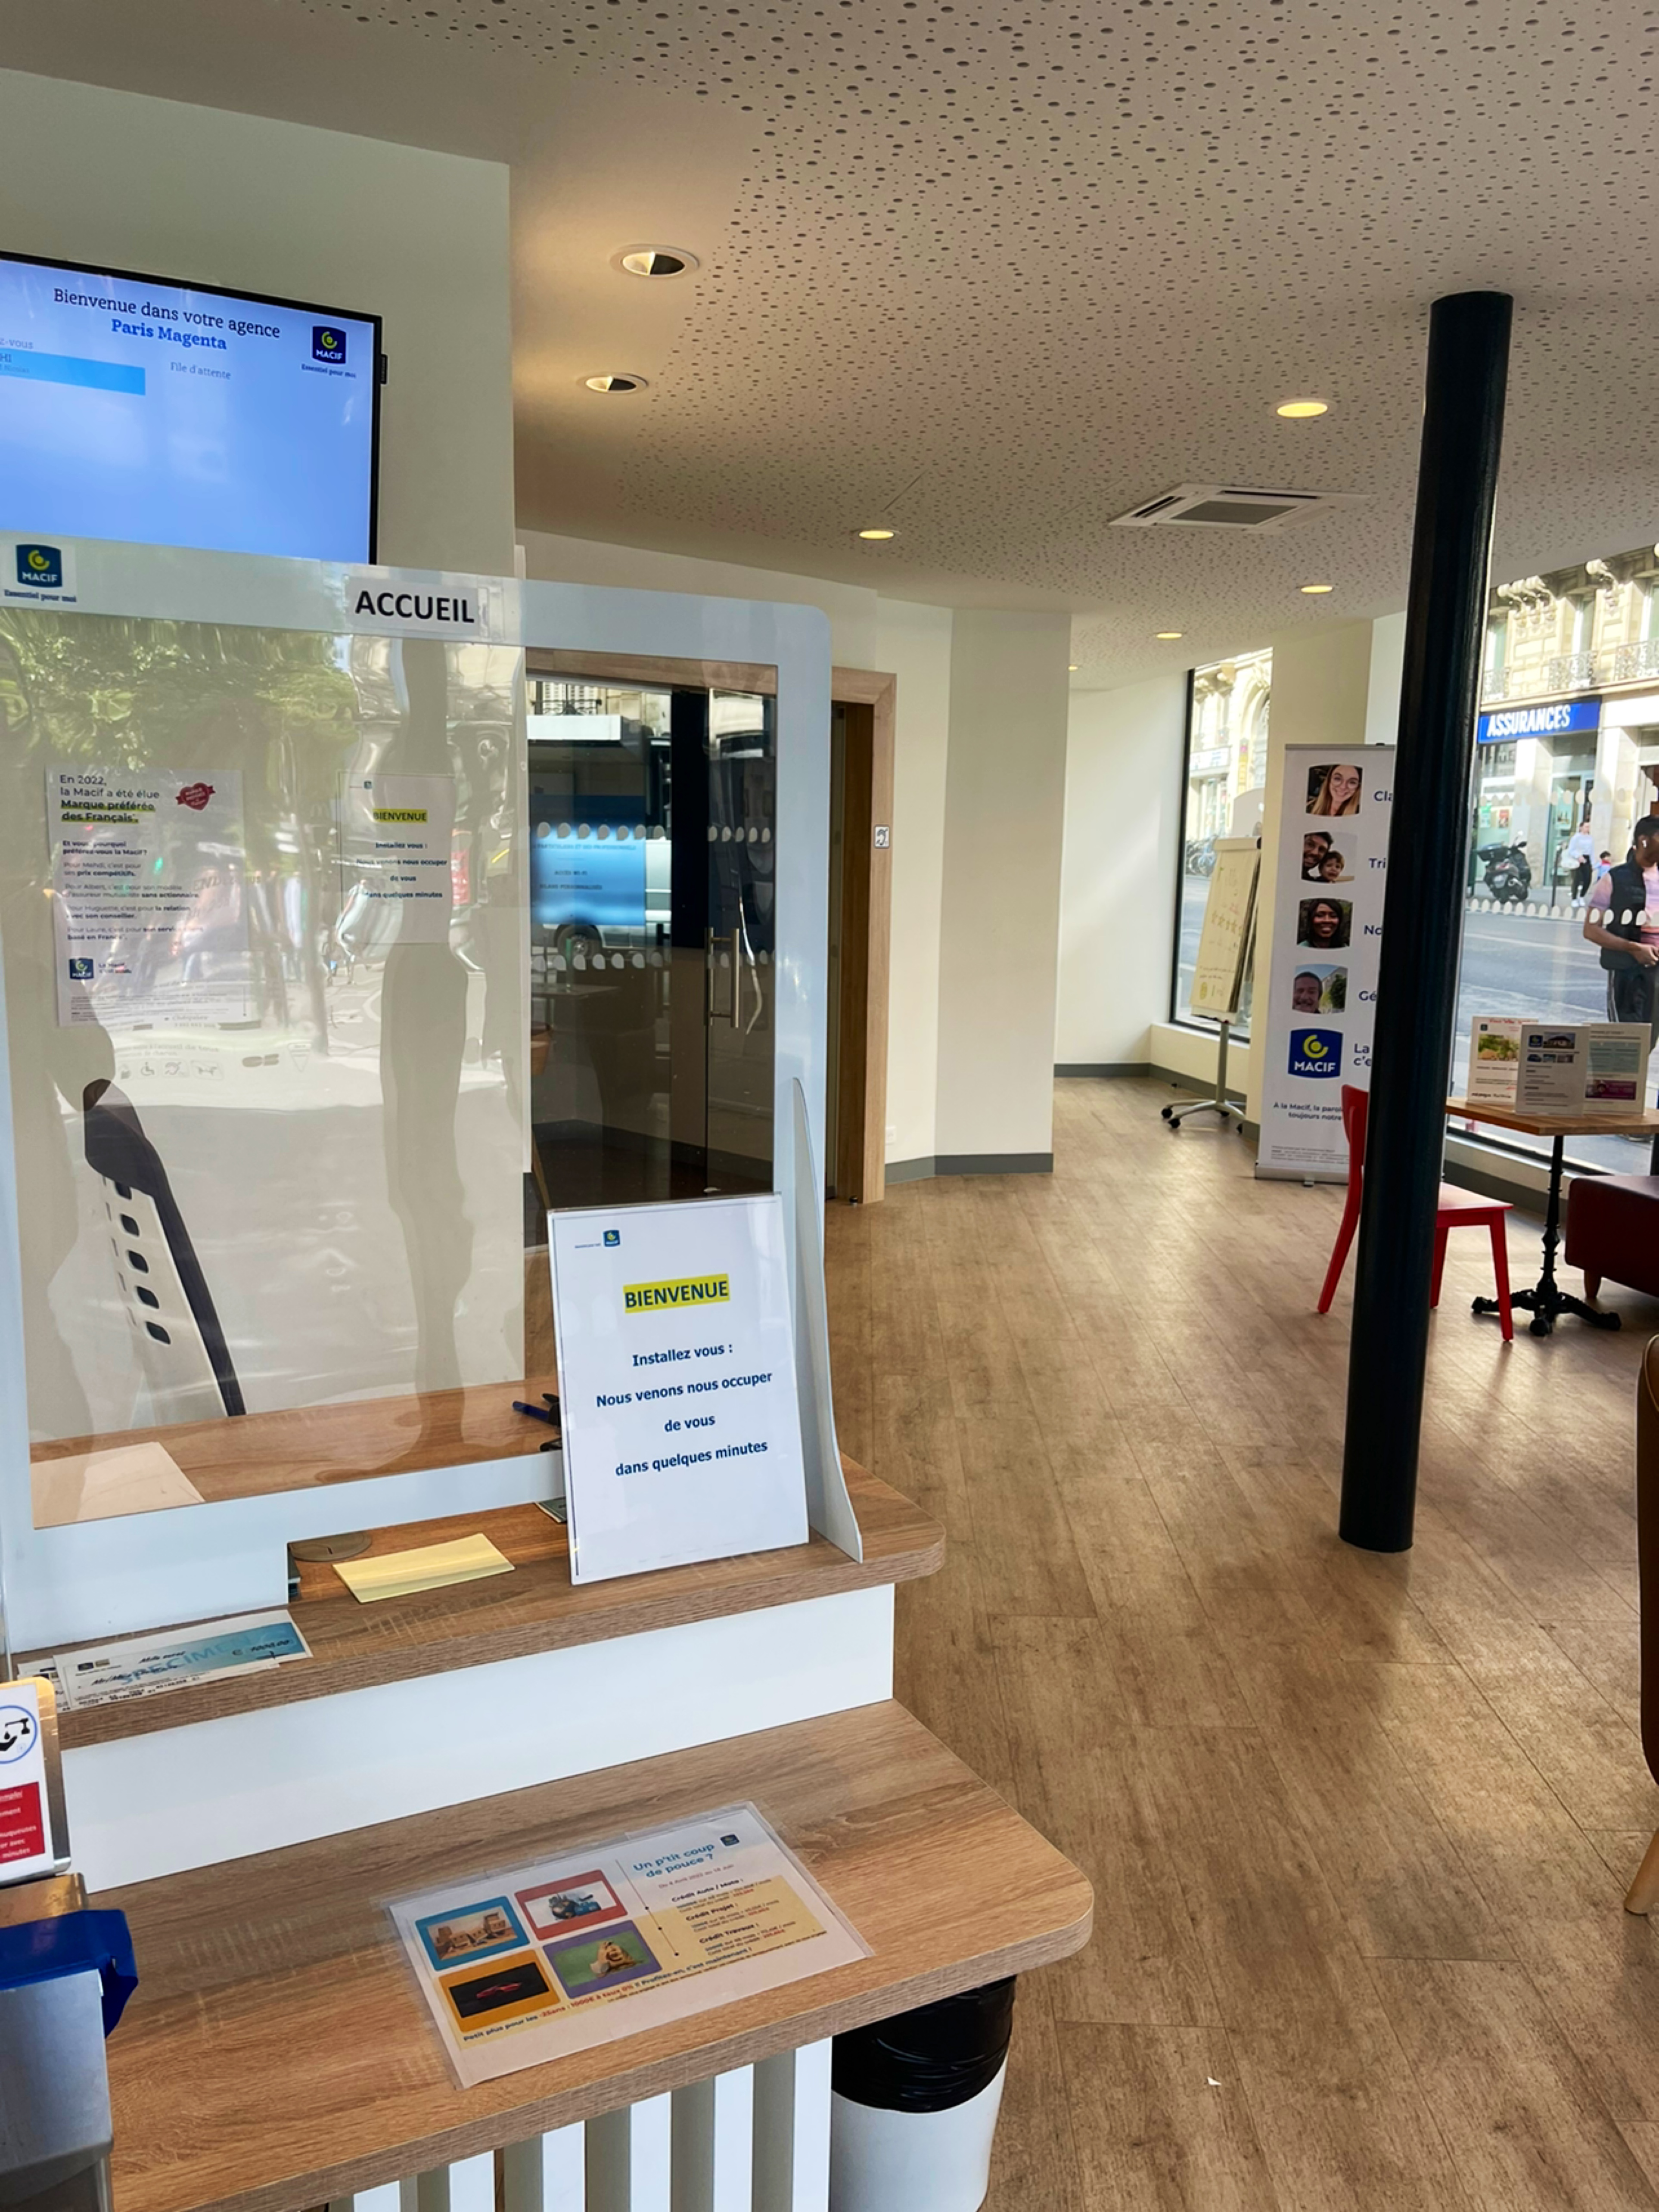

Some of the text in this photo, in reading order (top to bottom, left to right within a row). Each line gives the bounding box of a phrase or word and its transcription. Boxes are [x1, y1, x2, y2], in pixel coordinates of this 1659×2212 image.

[54, 288, 280, 338] Bienvenue dans votre agence
[112, 319, 227, 350] Paris Magenta
[316, 350, 343, 360] MACIF
[171, 361, 231, 379] File d'attente
[22, 572, 58, 583] MACIF
[355, 590, 474, 623] ACCUEIL
[1487, 704, 1571, 737] ASSURANCES
[60, 775, 107, 786] En 2022,
[60, 787, 70, 796] la
[74, 788, 103, 797] Macif
[116, 789, 134, 798] été
[137, 789, 159, 799] élue
[61, 800, 104, 811] Marque
[62, 812, 83, 822] des
[373, 812, 427, 821] BIENVENUE
[1369, 858, 1386, 869] Tri
[1354, 1044, 1370, 1053] La
[1294, 1061, 1336, 1072] MACIF
[624, 1280, 728, 1308] BIENVENUE
[632, 1349, 692, 1367] Installez
[694, 1345, 725, 1358] vous
[596, 1373, 772, 1407] Nous venons nous occuper
[664, 1416, 715, 1432] de vous
[615, 1442, 768, 1476] dans quelques minutes
[633, 1844, 715, 1871] Un p'tit coup
[646, 1869, 663, 1878] de
[665, 1858, 704, 1873] pouce
[672, 1892, 695, 1902] Crédit
[686, 1911, 710, 1921] Crédit
[711, 1904, 734, 1914] Projet
[699, 1933, 724, 1943] Crédit
[464, 2032, 484, 2041] Petit
[486, 2026, 503, 2035] plus
[505, 2019, 524, 2030] pour
[603, 1988, 621, 1998] taux
[705, 1948, 748, 1965] maintenant
